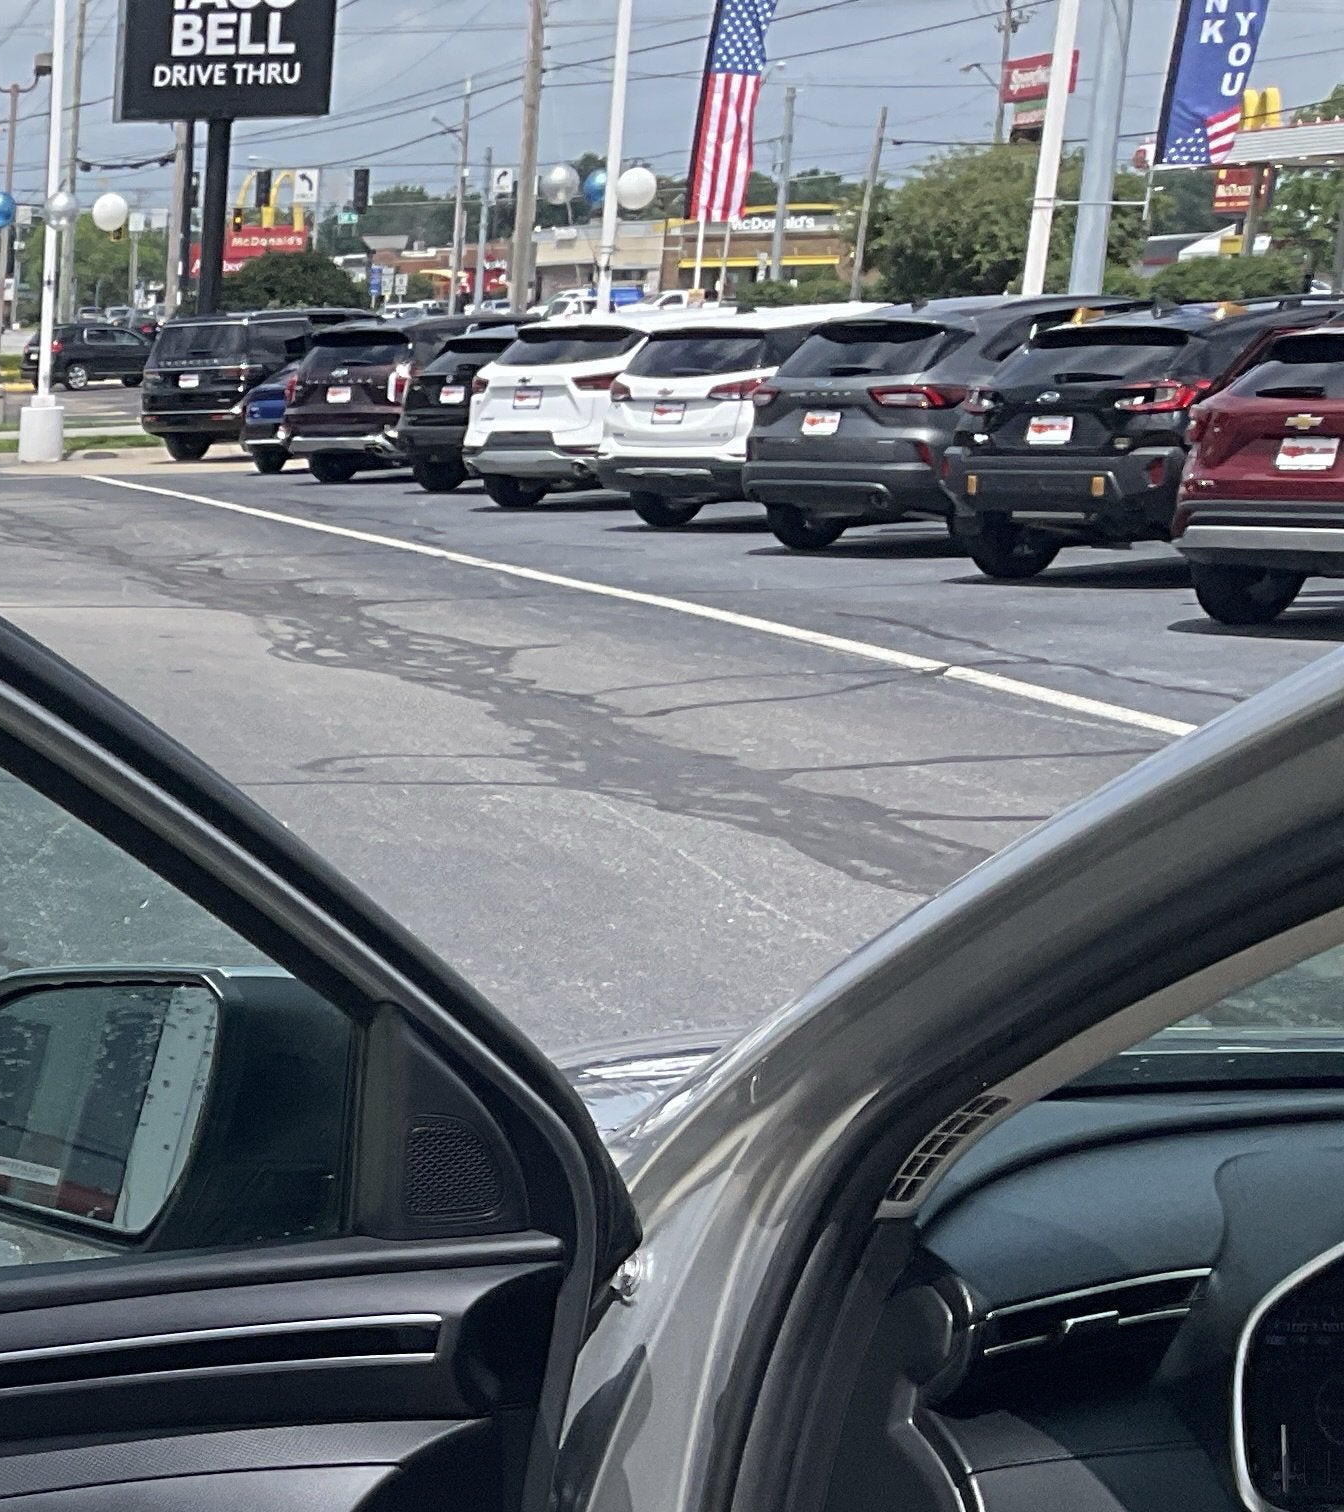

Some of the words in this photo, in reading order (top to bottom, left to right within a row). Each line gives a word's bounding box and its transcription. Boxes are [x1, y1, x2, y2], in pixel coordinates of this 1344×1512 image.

[170, 11, 297, 57] BELL
[1220, 11, 1257, 97] YOU
[152, 63, 228, 88] DRIVE
[231, 61, 302, 85] THRU
[231, 236, 304, 248] McDonald's
